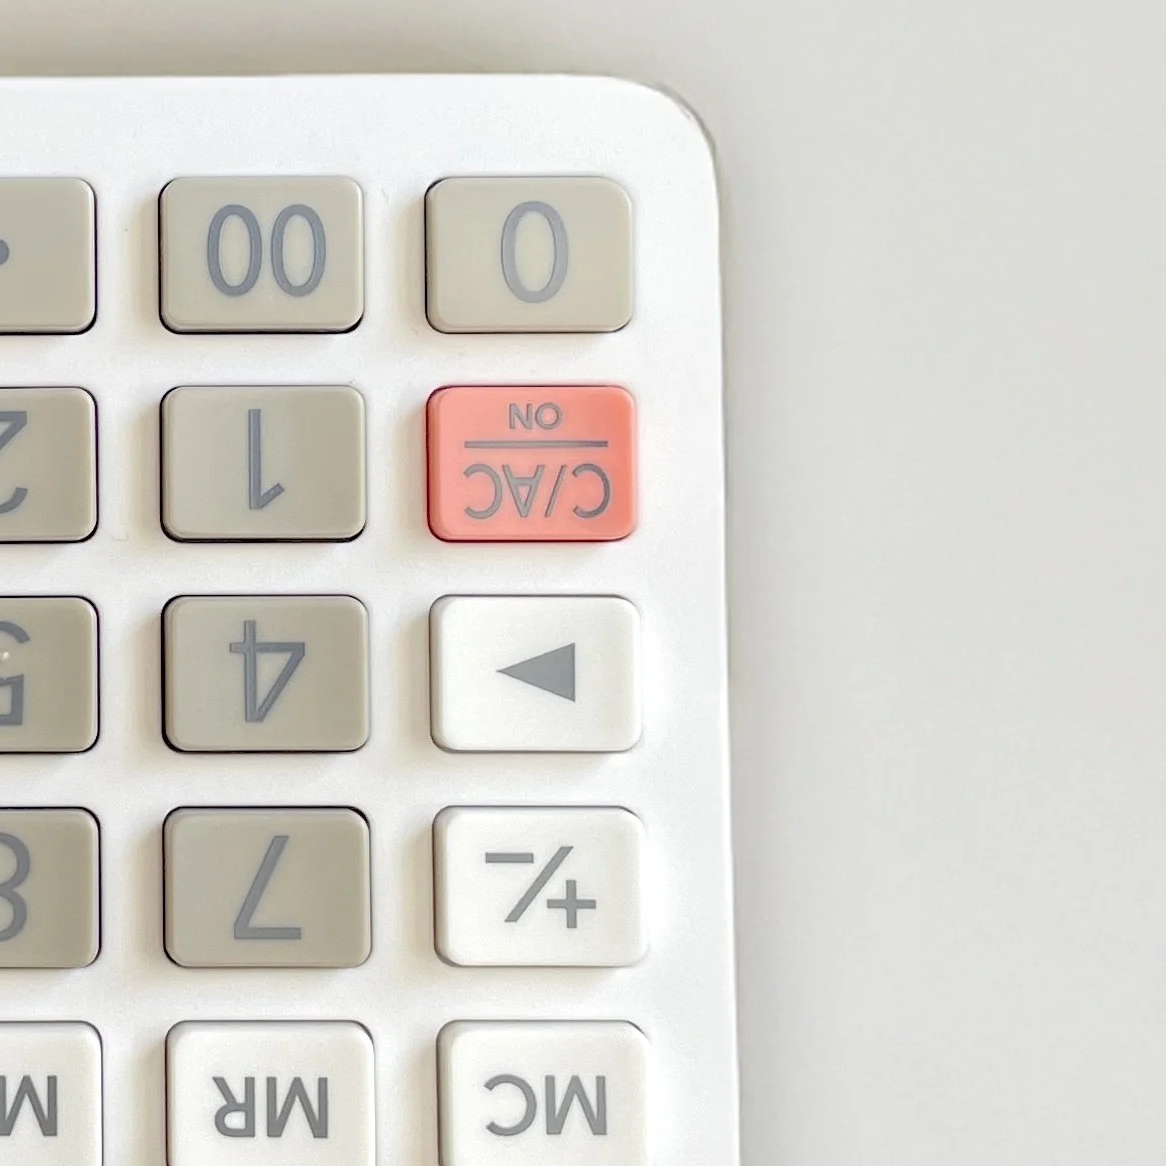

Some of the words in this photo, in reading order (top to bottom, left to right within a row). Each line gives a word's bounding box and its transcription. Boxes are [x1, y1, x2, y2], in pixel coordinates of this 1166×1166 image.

[206, 203, 327, 298] 00
[499, 200, 570, 304] 0
[247, 408, 287, 511] 1
[508, 401, 564, 431] ON
[462, 462, 612, 521] C/AC
[228, 619, 307, 724] 4
[232, 834, 303, 941] 7
[211, 1076, 329, 1140] MR
[483, 1073, 608, 1138] MC
